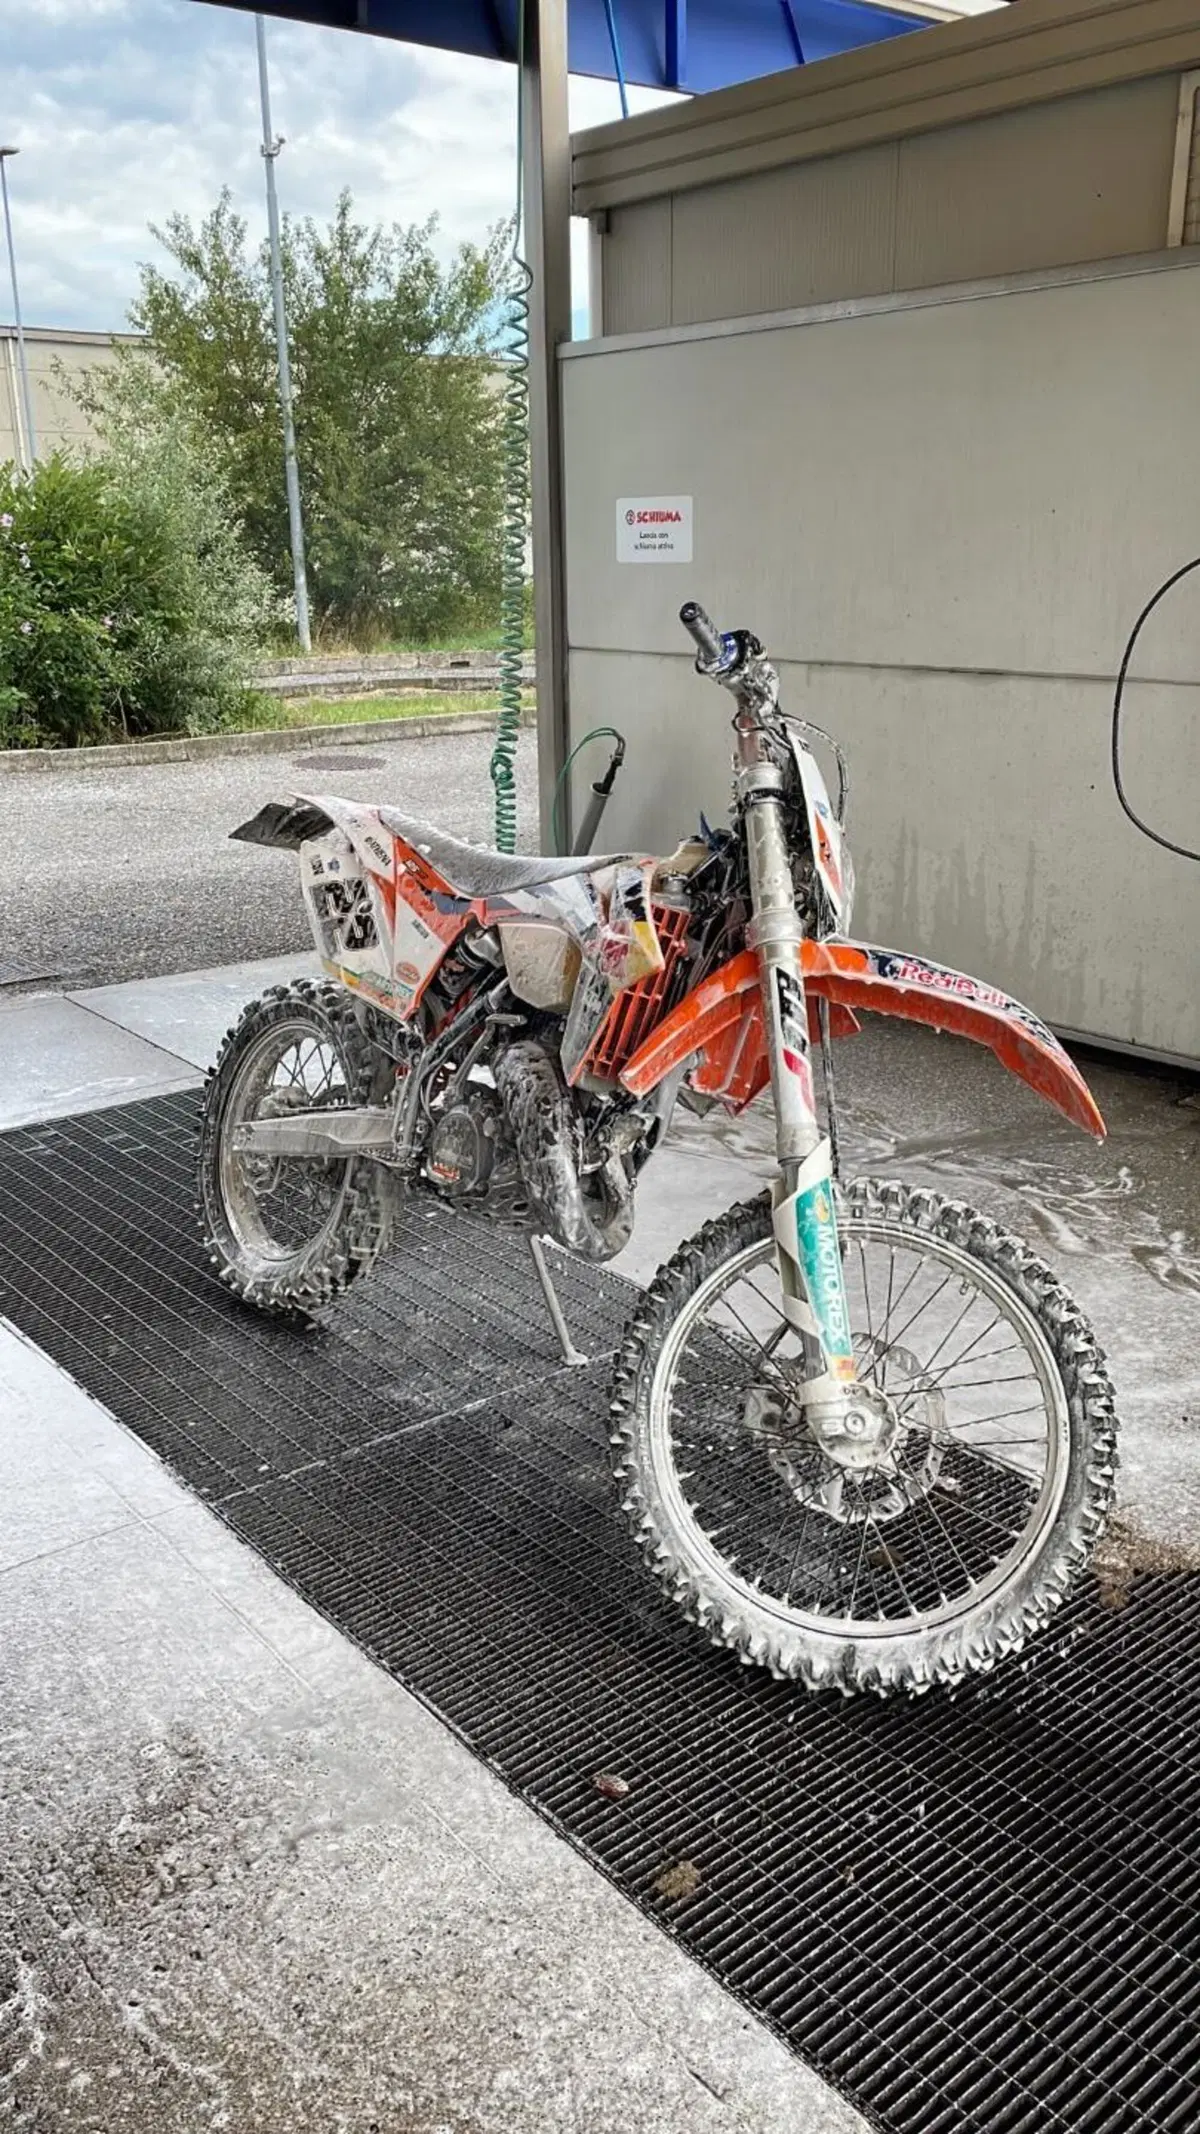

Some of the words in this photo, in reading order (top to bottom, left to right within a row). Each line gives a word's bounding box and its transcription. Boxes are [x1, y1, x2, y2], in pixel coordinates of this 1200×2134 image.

[637, 511, 681, 523] SCHIUMA
[900, 960, 951, 989] Red
[955, 976, 1007, 1009] Bull
[817, 1225, 847, 1348] MOTOREX
